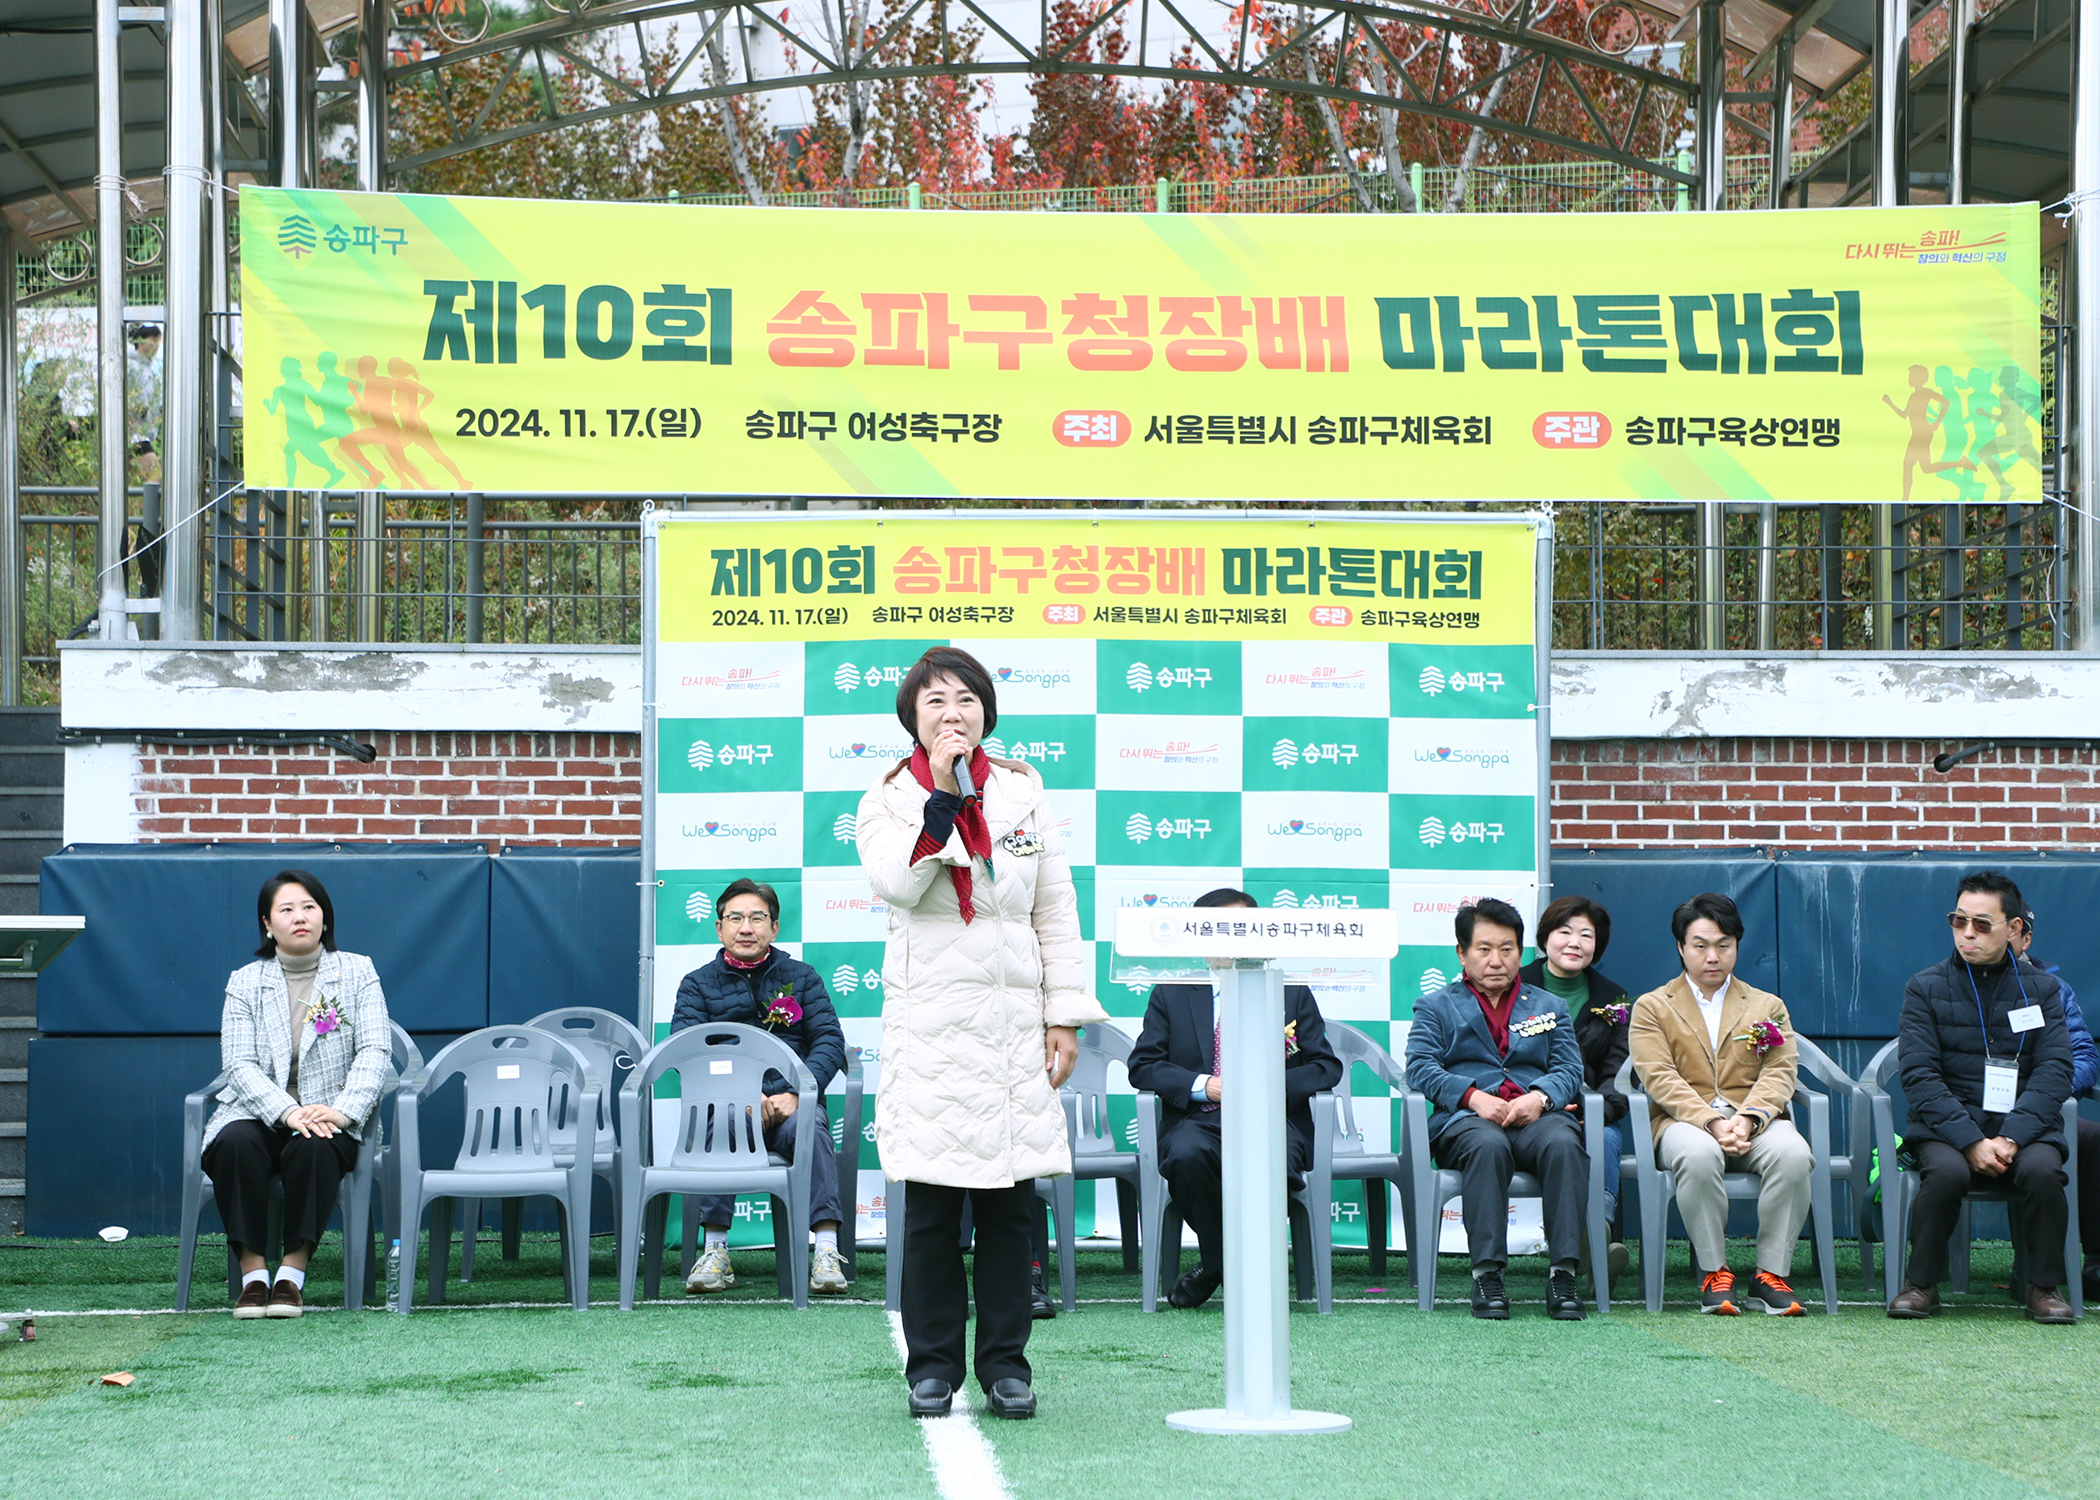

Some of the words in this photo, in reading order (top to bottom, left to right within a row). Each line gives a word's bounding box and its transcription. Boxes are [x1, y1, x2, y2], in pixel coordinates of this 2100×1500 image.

[323, 223, 408, 256] 송파구
[1845, 243, 1880, 259] 다시
[1882, 243, 1916, 259] 뛰는
[1920, 230, 1960, 247] 송파!
[1918, 253, 1950, 264] 창의와
[423, 279, 732, 366] 제10회
[766, 290, 1350, 373] 송파구청장배
[1373, 289, 1865, 375] 마라톤대회
[456, 408, 551, 438] 2024.
[560, 409, 597, 438] 11.
[606, 408, 701, 439] 17.(일)
[746, 410, 837, 440] 송파구
[849, 412, 1002, 443] 여성축구장
[1062, 414, 1118, 443] 주최
[1145, 415, 1296, 444] 서울특별시
[1308, 416, 1491, 445] 송파구체육회
[1544, 416, 1600, 444] 주관
[1626, 416, 1840, 447] 송파구육상연맹
[711, 545, 876, 597] 제10회
[893, 545, 1205, 597] 송파구청장배
[1221, 547, 1482, 600] 마라톤대회
[713, 609, 764, 626] 2024.
[770, 610, 789, 625] 11.
[795, 607, 849, 626] 17.(일)
[873, 606, 923, 623] 송파구
[929, 606, 1014, 624] 여성축구장
[1048, 606, 1080, 623] 주최
[1094, 607, 1178, 624] 서울특별시
[1185, 608, 1287, 625] 송파구체육회
[1314, 608, 1347, 625] 주관
[1361, 609, 1480, 629] 송파구육상연맹
[681, 676, 703, 687] 다시
[704, 676, 725, 687] 뛰는
[727, 668, 753, 679] 송파!
[1014, 670, 1070, 688] Songpa
[1156, 667, 1213, 688] 송파구
[1266, 674, 1287, 684] 다시
[1289, 674, 1309, 684] 뛰는
[1311, 667, 1337, 677] 송파!
[1449, 672, 1505, 693] 송파구
[717, 744, 774, 766] 송파구
[1009, 741, 1067, 763] 송파구
[1119, 748, 1141, 758] 다시
[1142, 748, 1163, 759] 뛰는
[1165, 741, 1191, 752] 송파!
[1302, 743, 1359, 764] 송파구
[1415, 749, 1437, 762] We
[1453, 750, 1509, 769] Songpa
[682, 825, 705, 837] We
[721, 824, 777, 842] Songpa
[1155, 818, 1212, 839] 송파구
[1267, 823, 1290, 835] We
[1306, 822, 1362, 841] Songpa
[1449, 822, 1505, 843] 송파구
[826, 899, 847, 910] 다시
[849, 899, 869, 910] 뛰는
[1413, 902, 1435, 913] 다시
[1184, 921, 1363, 938] 서울특별시송파구체육회
[734, 1201, 772, 1222] 파구
